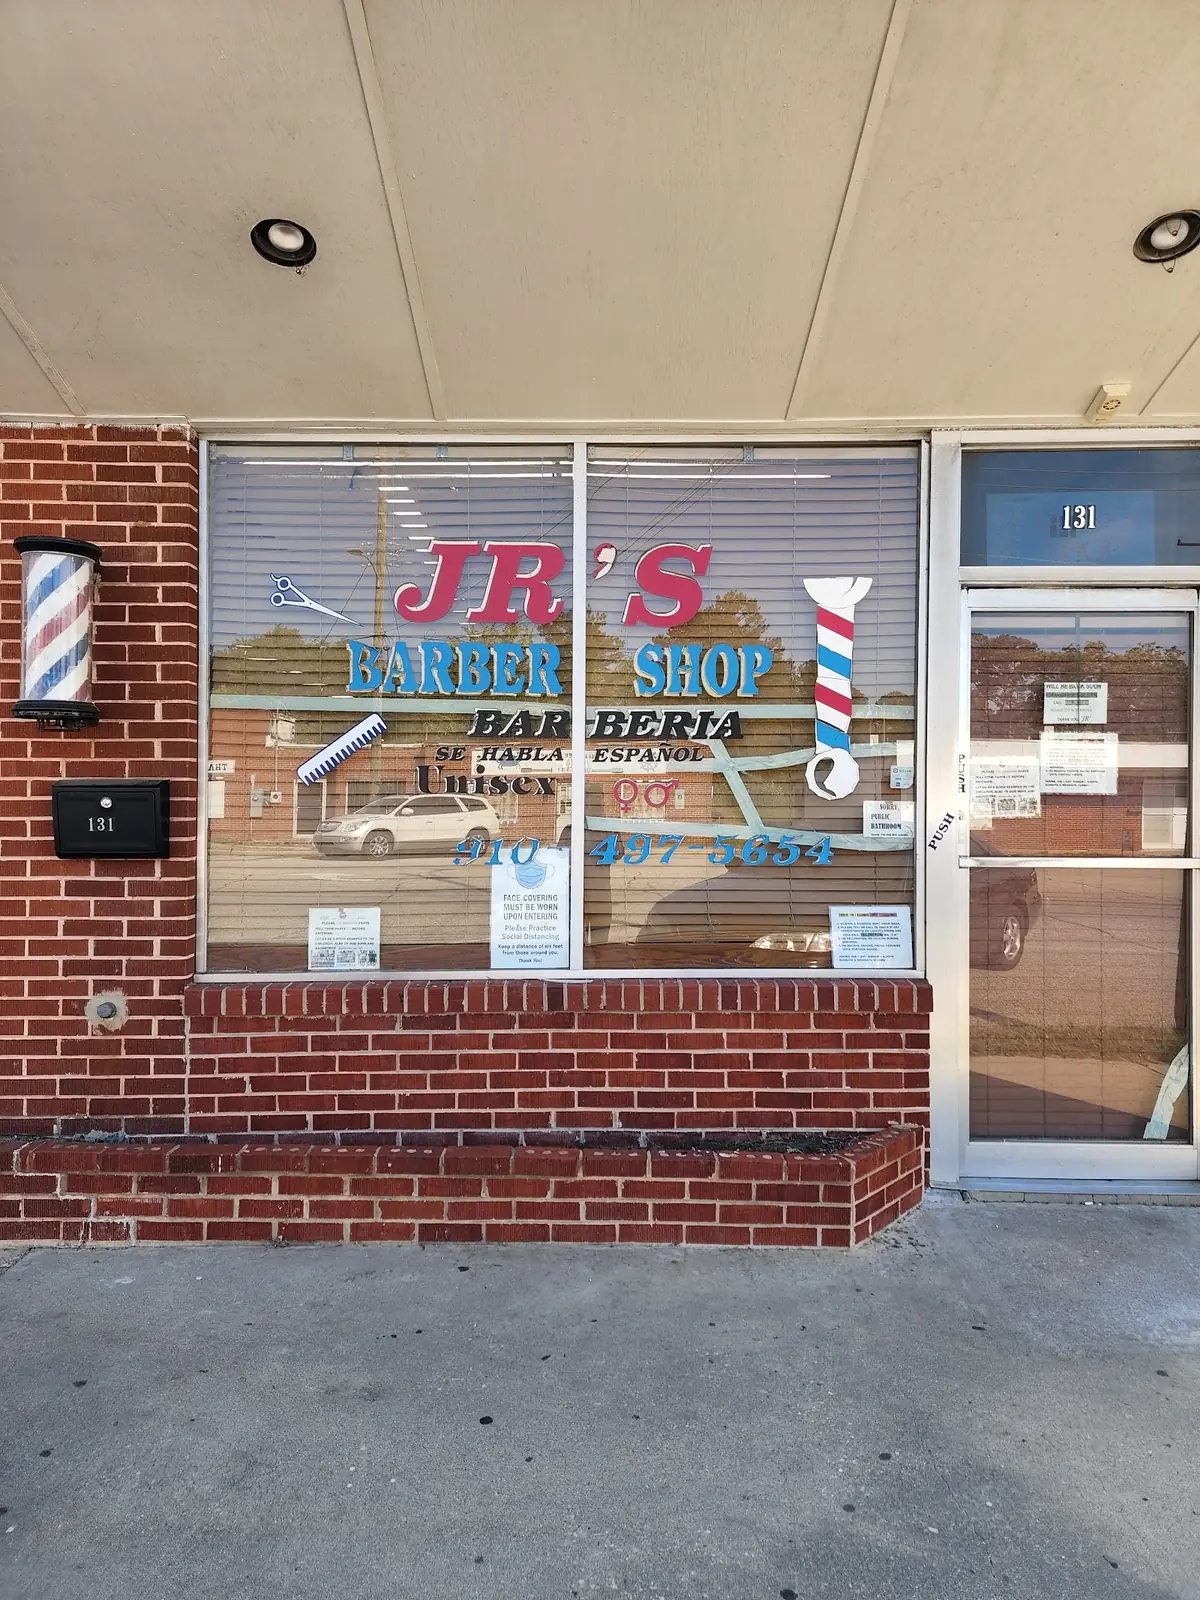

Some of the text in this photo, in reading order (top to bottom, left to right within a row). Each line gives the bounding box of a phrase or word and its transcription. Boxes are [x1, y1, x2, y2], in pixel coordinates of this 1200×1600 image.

[1063, 505, 1096, 529] 131
[346, 640, 773, 698] BARBER SHOP
[435, 742, 705, 763] SE HABLA ESPAÑOL
[415, 765, 556, 796] Unisex
[88, 817, 114, 832] 131
[928, 812, 955, 850] PUSH
[452, 834, 834, 866] 910 497-5654
[503, 894, 558, 902] FACE COVERING
[503, 903, 558, 911] MUST BE WORN
[503, 912, 558, 920] UPON ENTERING
[505, 924, 556, 932] Please Practice
[524, 933, 560, 941] Distancing
